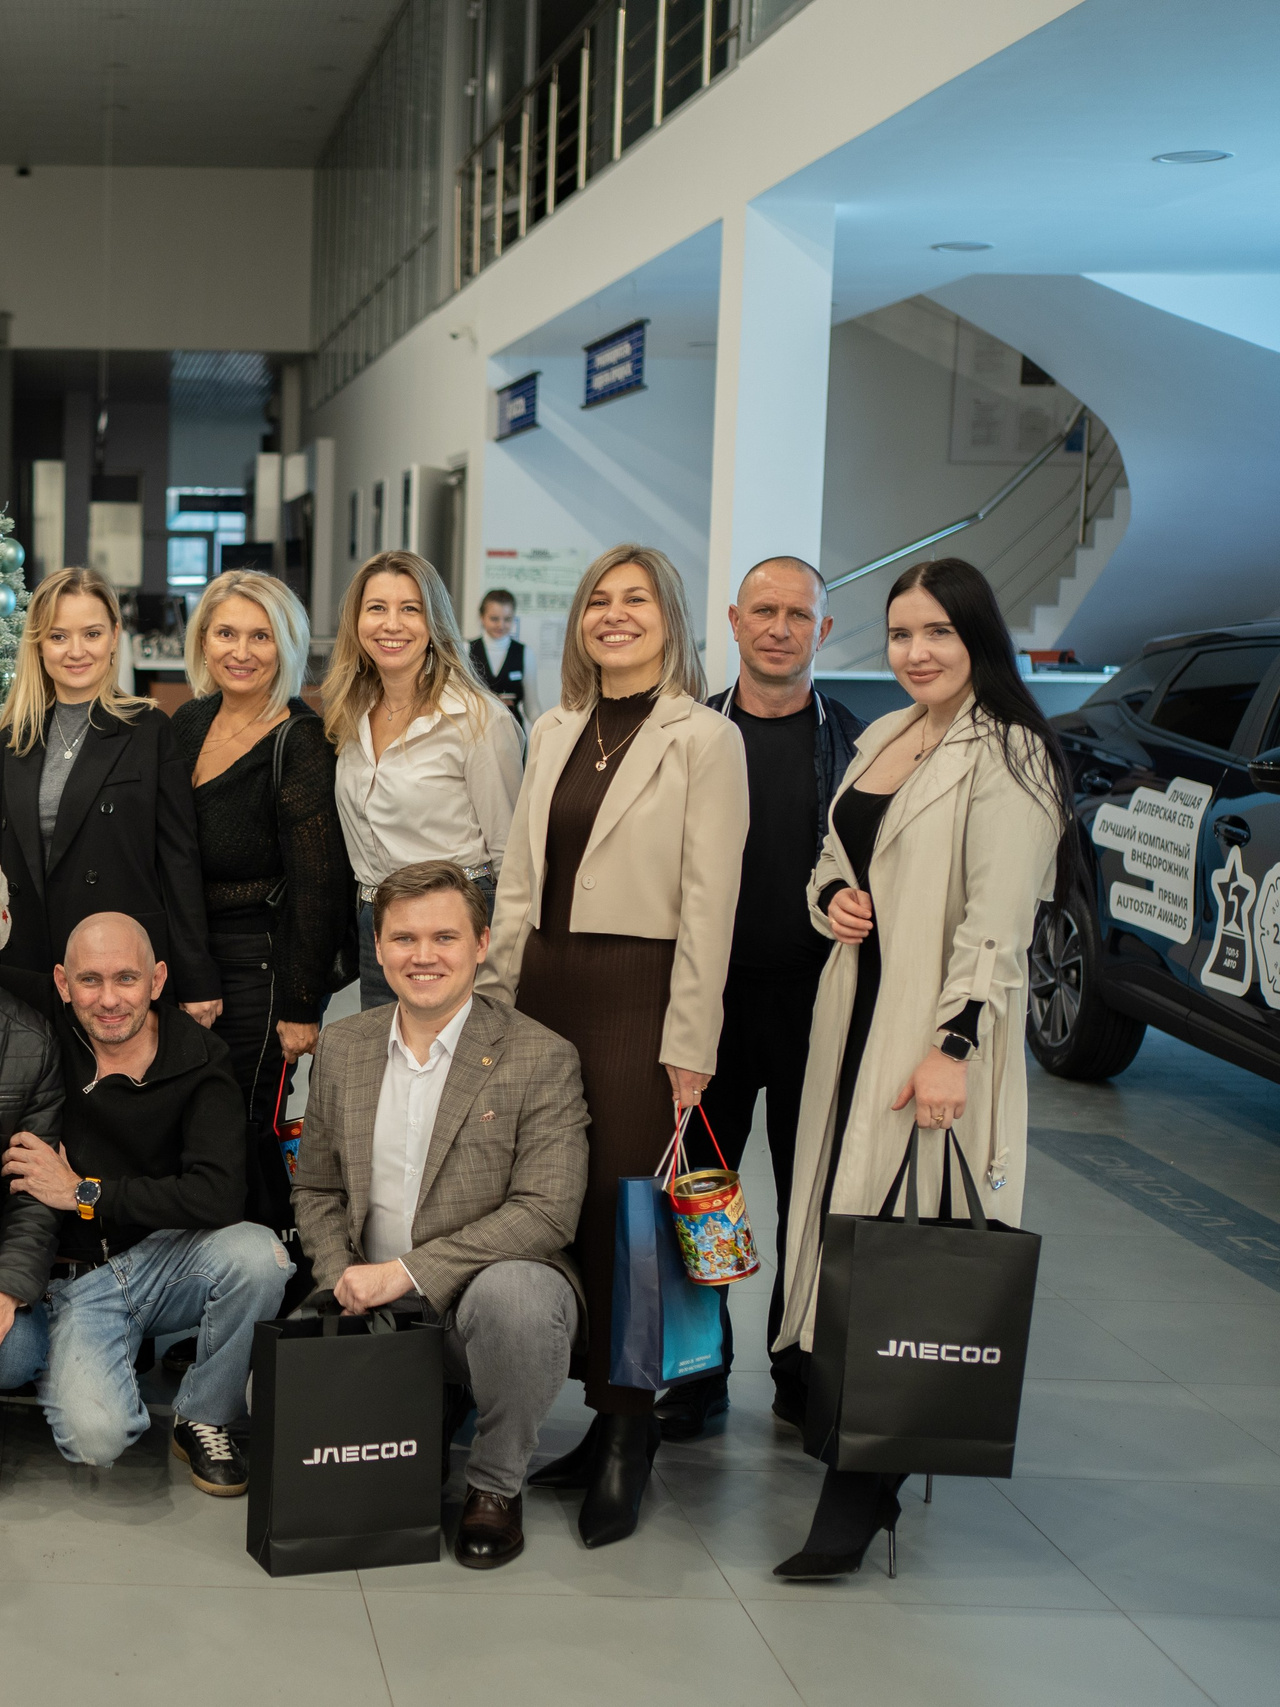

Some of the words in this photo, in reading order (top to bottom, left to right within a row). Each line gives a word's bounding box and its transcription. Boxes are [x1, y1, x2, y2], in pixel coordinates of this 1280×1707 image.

[1169, 790, 1203, 809] ЛУЧШАЯ
[1133, 799, 1178, 824] ДИЛЕРСКАЯ
[1178, 813, 1194, 829] СЕТЬ
[1099, 819, 1137, 841] ЛУЧШИЙ
[1138, 831, 1190, 860] КОМПАКТНЫЙ
[1131, 848, 1189, 880] ВНЕДОРОЖНИК
[1159, 888, 1188, 911] ПРЕМИЯ
[1117, 895, 1157, 918] AUTOSTAT
[1157, 907, 1187, 931] AWARDS
[1223, 958, 1237, 969] АВТО
[876, 1339, 1001, 1364] JAECOO
[302, 1439, 417, 1465] JAECOO
